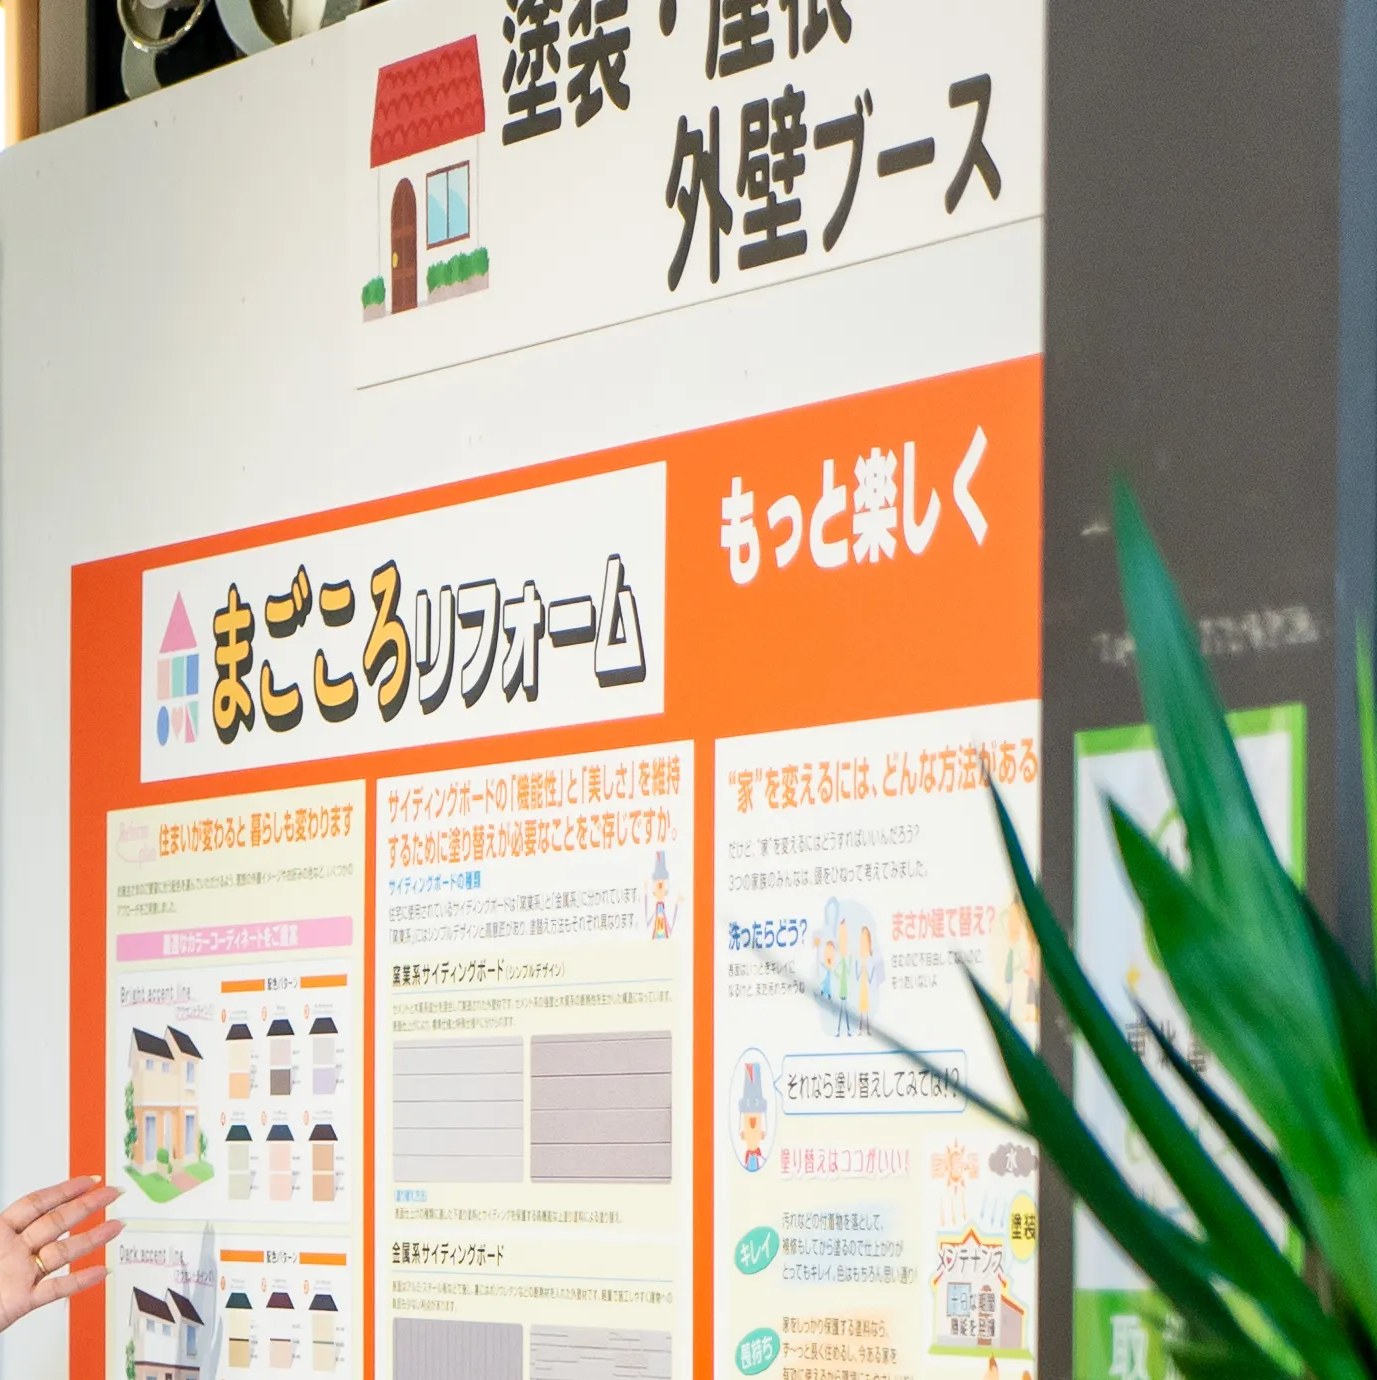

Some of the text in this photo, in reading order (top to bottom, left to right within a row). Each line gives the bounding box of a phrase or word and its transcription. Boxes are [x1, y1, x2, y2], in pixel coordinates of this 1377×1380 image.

[665, 72, 1003, 292] 外壁ブース
[720, 424, 991, 585] もっと楽しく
[212, 553, 647, 746] まごころリフォーム
[388, 754, 681, 824] サイディングボードの「機能性」と「美しさ」を維持
[158, 802, 354, 857] 住まいが変わると 暮らしも変わります
[388, 806, 678, 869] するために塗り替えが必要なことをご存じですか。
[728, 918, 808, 951] 洗ったらどう?
[391, 1241, 505, 1267] 金属系サイディングボード
[739, 1240, 771, 1268] キレイ
[936, 1248, 1004, 1275] メンテナンス
[740, 1335, 773, 1370] 長持ち
